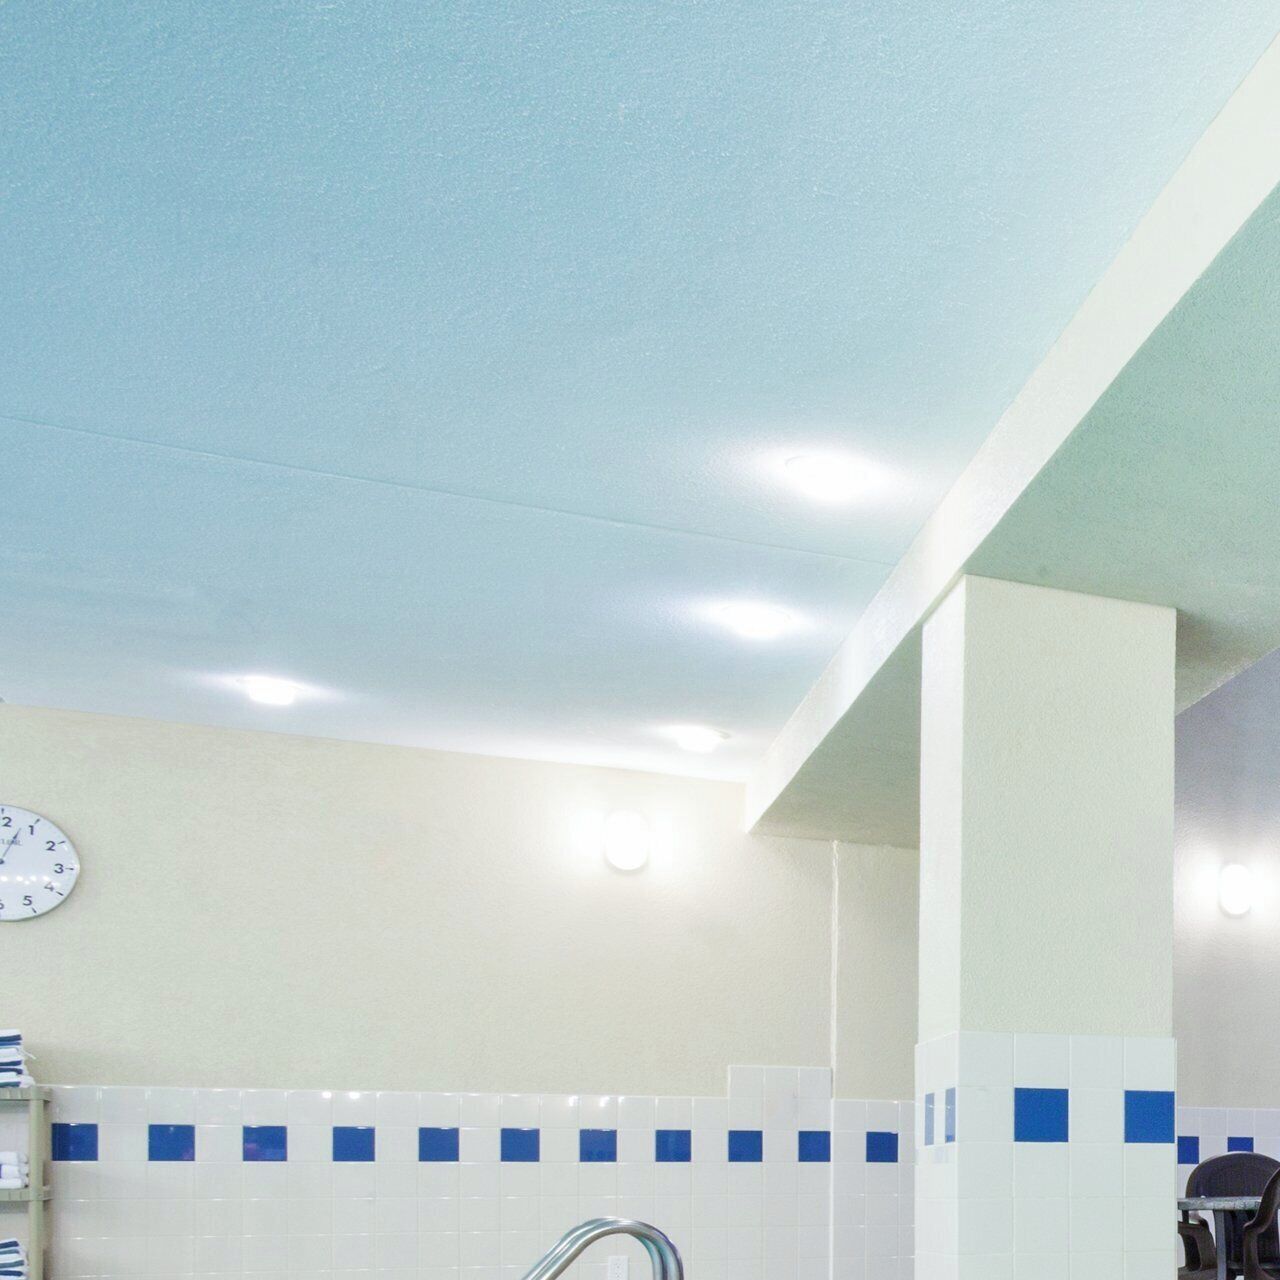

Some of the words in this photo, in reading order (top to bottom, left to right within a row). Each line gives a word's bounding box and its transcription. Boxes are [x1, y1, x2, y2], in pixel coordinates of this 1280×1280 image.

[28, 825, 34, 835] 1
[46, 840, 55, 851] 2
[54, 863, 64, 873] 3
[44, 881, 54, 891] 4
[23, 895, 32, 906] 5
